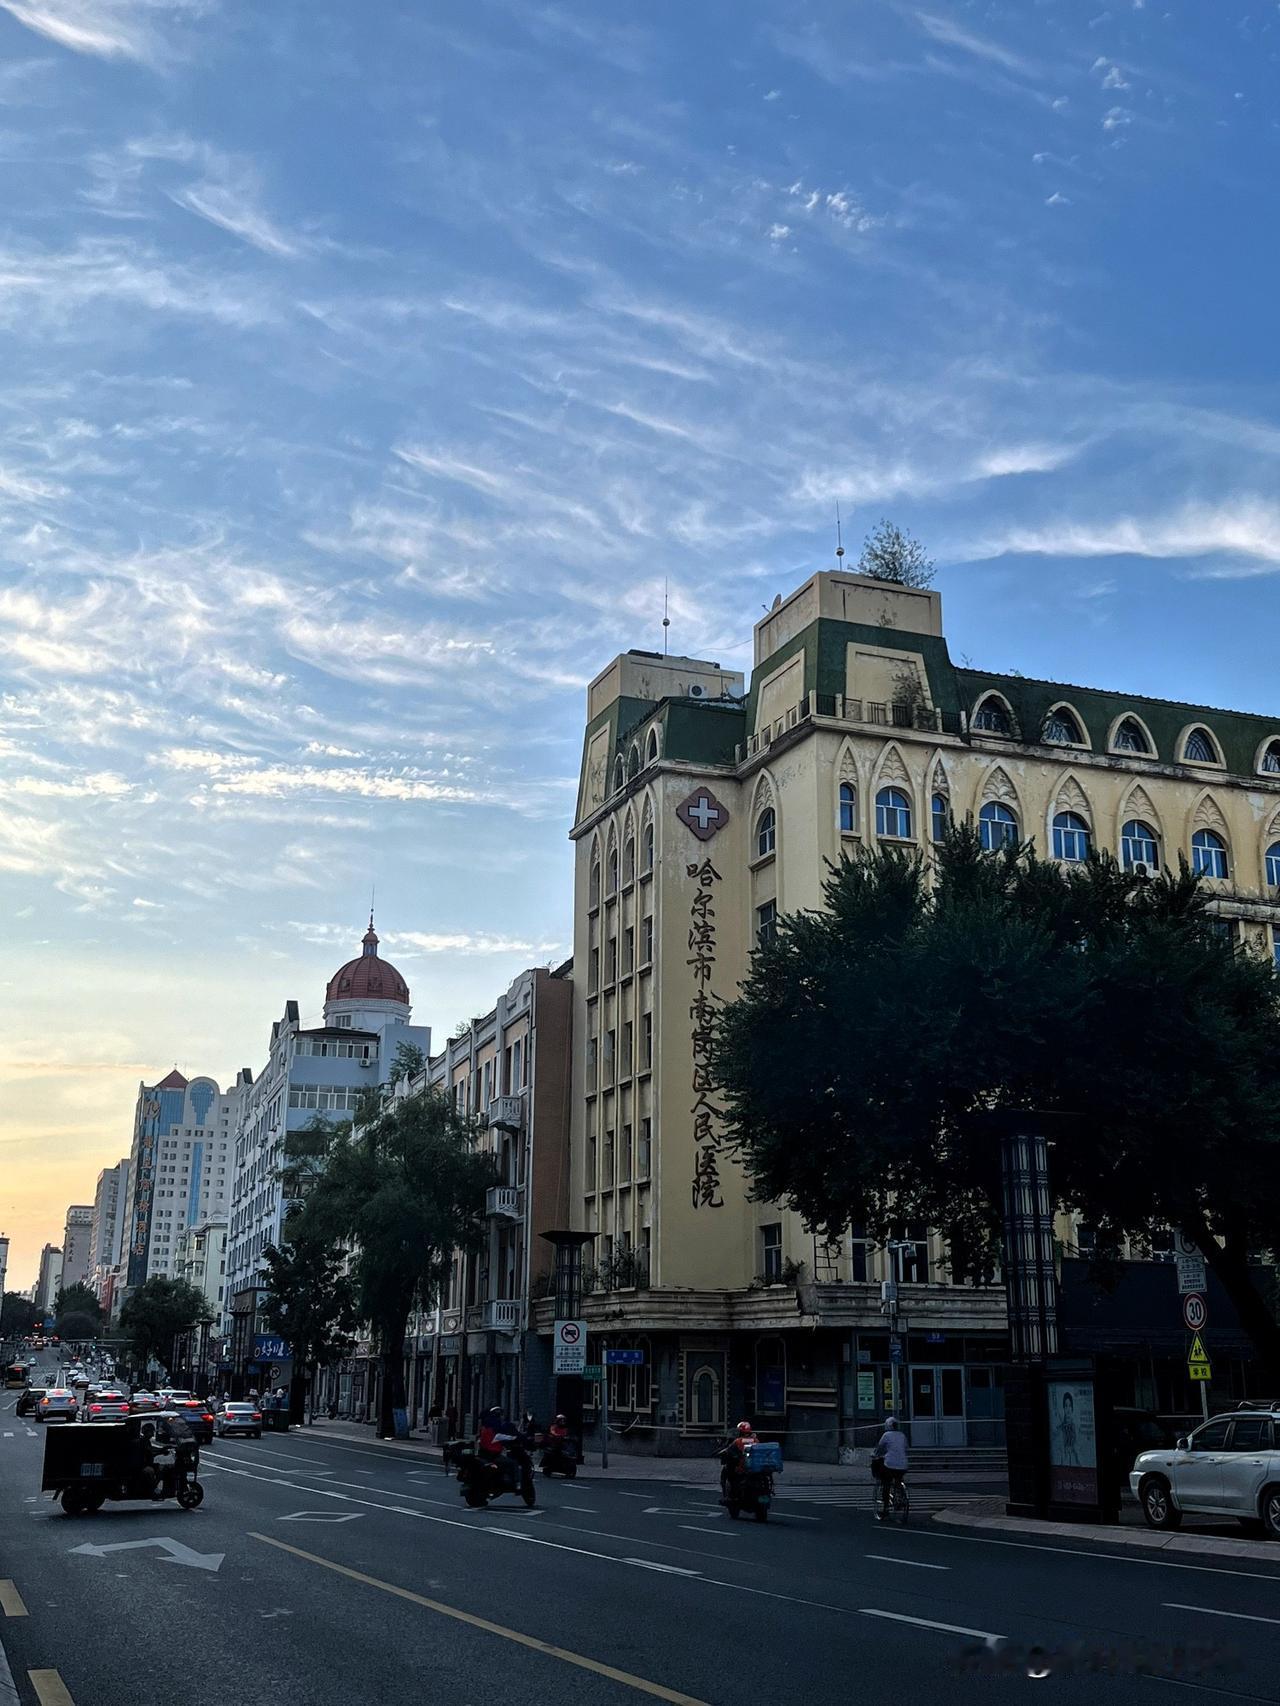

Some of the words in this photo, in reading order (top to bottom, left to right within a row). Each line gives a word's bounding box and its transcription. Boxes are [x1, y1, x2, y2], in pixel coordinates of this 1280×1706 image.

[686, 857, 723, 1209] 哈尔滨市南岗区人民医院
[1188, 1302, 1202, 1321] 30
[1192, 1367, 1208, 1377] 学校
